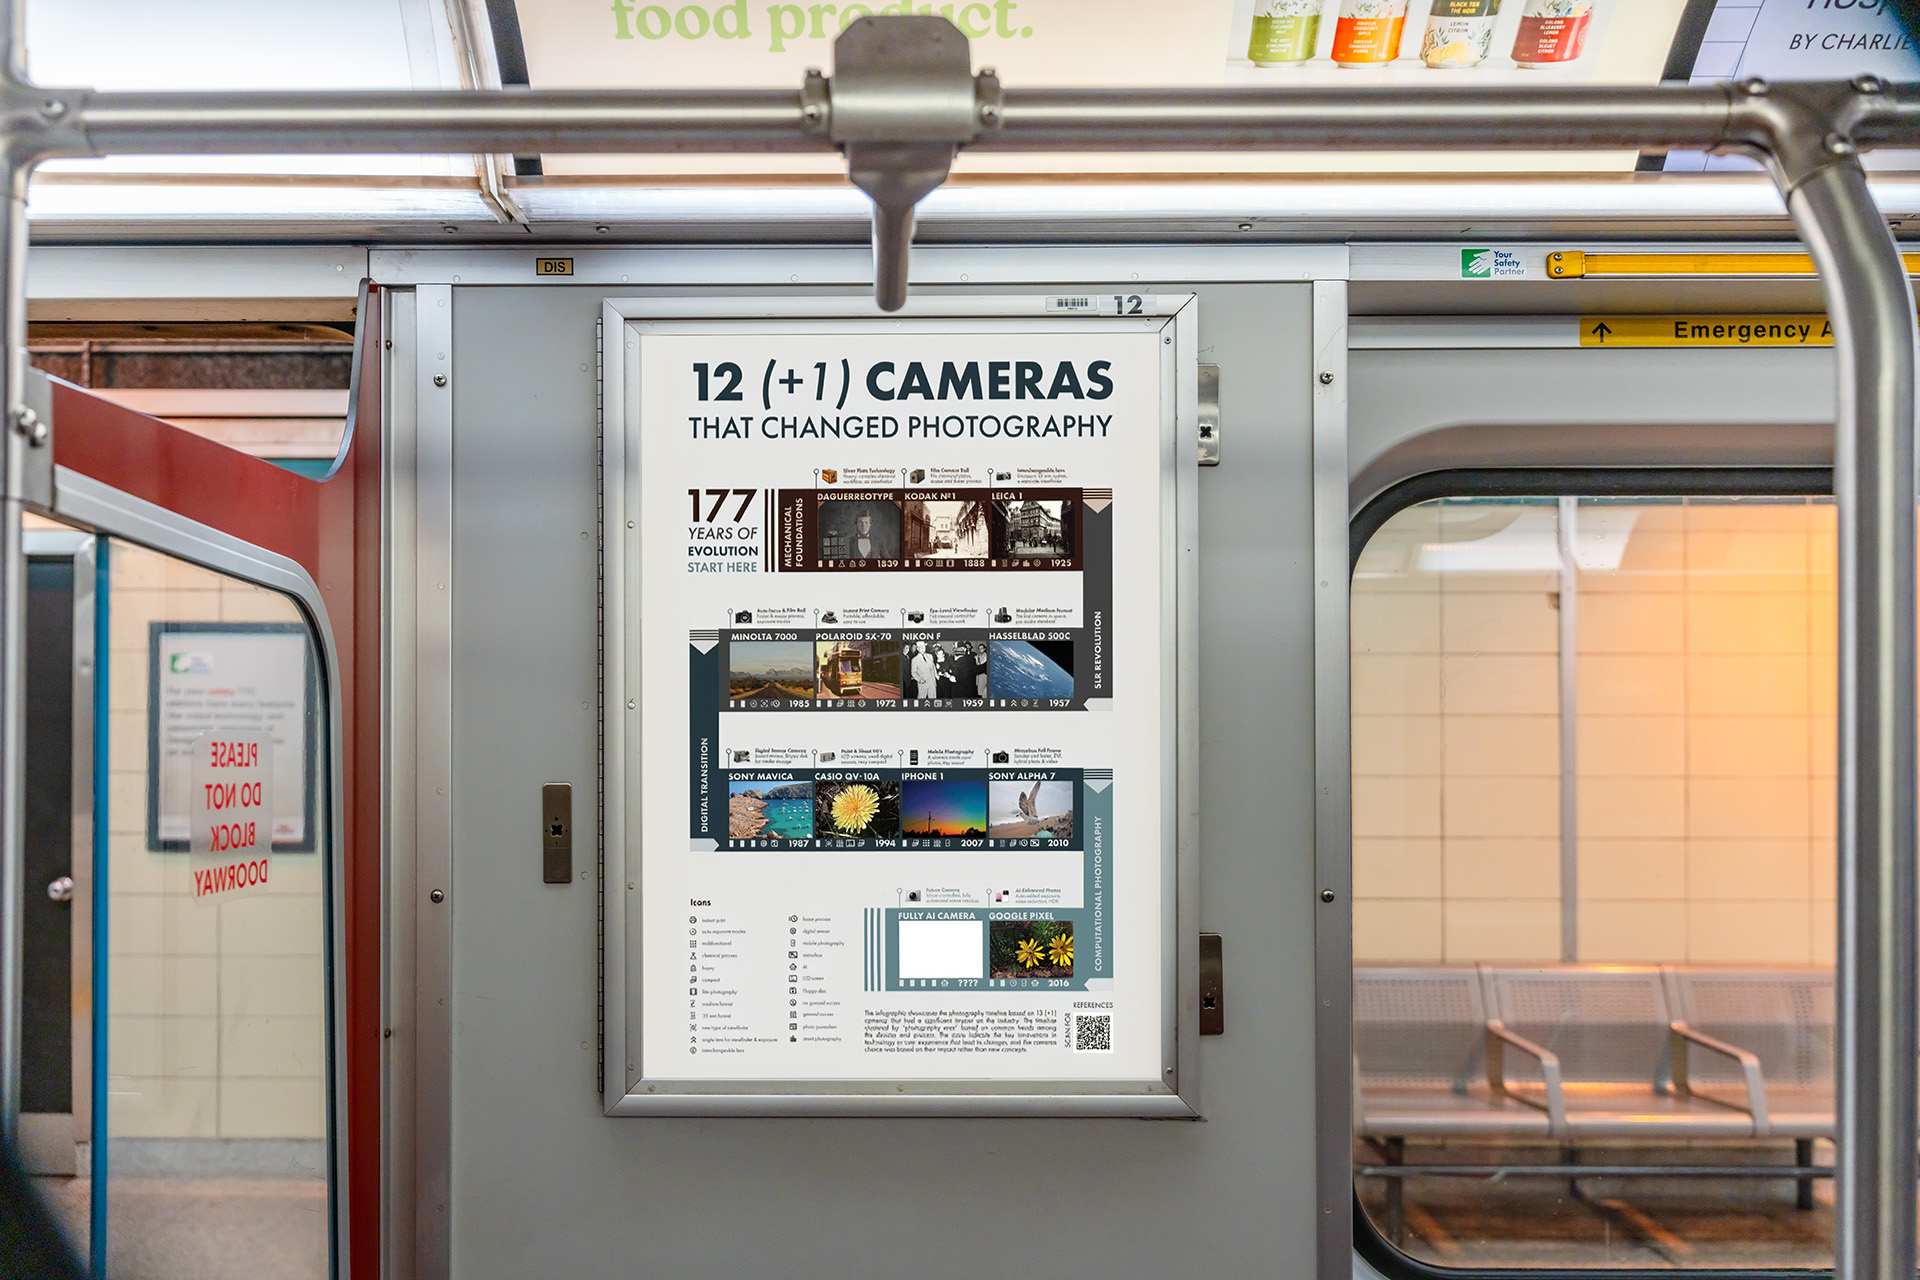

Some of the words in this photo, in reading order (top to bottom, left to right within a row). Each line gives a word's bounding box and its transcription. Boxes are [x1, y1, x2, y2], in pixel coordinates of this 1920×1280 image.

[611, 0, 752, 40] food
[1789, 33, 1818, 50] BY
[1493, 250, 1513, 259] Your
[544, 261, 566, 273] DIS
[1493, 259, 1521, 269] Safety
[1494, 267, 1526, 276] Partner
[1113, 294, 1143, 315] 12
[1674, 321, 1811, 343] Emergency
[693, 362, 742, 401] 12
[763, 359, 849, 410] (+1)
[866, 360, 1113, 401] CAMERAS
[689, 417, 753, 438] THAT
[762, 416, 898, 438] CHANGED
[909, 415, 1112, 438] PHOTOGRAPHY
[817, 492, 894, 501] DAGUERREOTYPE
[904, 492, 938, 501] KODAK
[991, 491, 1016, 500] LEICA
[688, 489, 757, 523] 177
[689, 527, 732, 539] YEARS
[738, 527, 757, 539] OF
[784, 505, 792, 568] MECHANICAL
[795, 497, 804, 567] FOUNDATIONS
[688, 545, 759, 557] EVOLUTION
[687, 561, 724, 573] START
[726, 561, 757, 573] HERE
[877, 559, 899, 568] 1839
[964, 559, 985, 568] 1888
[1051, 558, 1072, 567] 1925
[731, 632, 773, 641] MINOLTA
[774, 632, 798, 641] 7000
[815, 632, 863, 641] POLAROID
[864, 632, 892, 641] SX-70
[902, 632, 934, 641] NIKON
[936, 632, 941, 640] F
[988, 632, 1046, 641] HASSELBLAD
[1047, 631, 1071, 641] 500C
[1094, 611, 1102, 671] REVOLUTION
[1094, 672, 1102, 689] SLR
[789, 699, 810, 708] 1985
[875, 699, 896, 708] 1972
[962, 698, 984, 708] 1959
[1049, 698, 1071, 708] 1957
[700, 737, 709, 795] TRANSITION
[728, 772, 755, 781] SONY
[756, 772, 794, 781] MAVICA
[814, 772, 843, 781] CASIO
[844, 772, 880, 781] QV-10A
[901, 772, 938, 781] IPHONE
[939, 772, 944, 781] 1
[988, 772, 1016, 781] SONY
[1016, 772, 1048, 780] ALPHA
[1049, 772, 1056, 780] 7
[700, 796, 709, 833] DIGITAL
[788, 839, 810, 848] 1987
[875, 839, 896, 848] 1994
[960, 838, 984, 848] 2007
[1047, 838, 1070, 847] 2010
[1094, 815, 1102, 889] PHOTOGRAPHY
[690, 898, 712, 907] Icons
[898, 912, 924, 920] FULLY
[925, 912, 936, 920] AI
[937, 911, 976, 920] CAMERA
[988, 911, 1028, 921] GOOGLE
[1029, 911, 1055, 921] PIXEL
[1094, 890, 1103, 972] COMPUTATIONAL
[957, 978, 979, 987] ????
[1047, 979, 1070, 988] 2016
[1072, 1001, 1114, 1009] REFERENCES
[1064, 1012, 1072, 1027] FOR
[1064, 1027, 1072, 1048] SCAN
